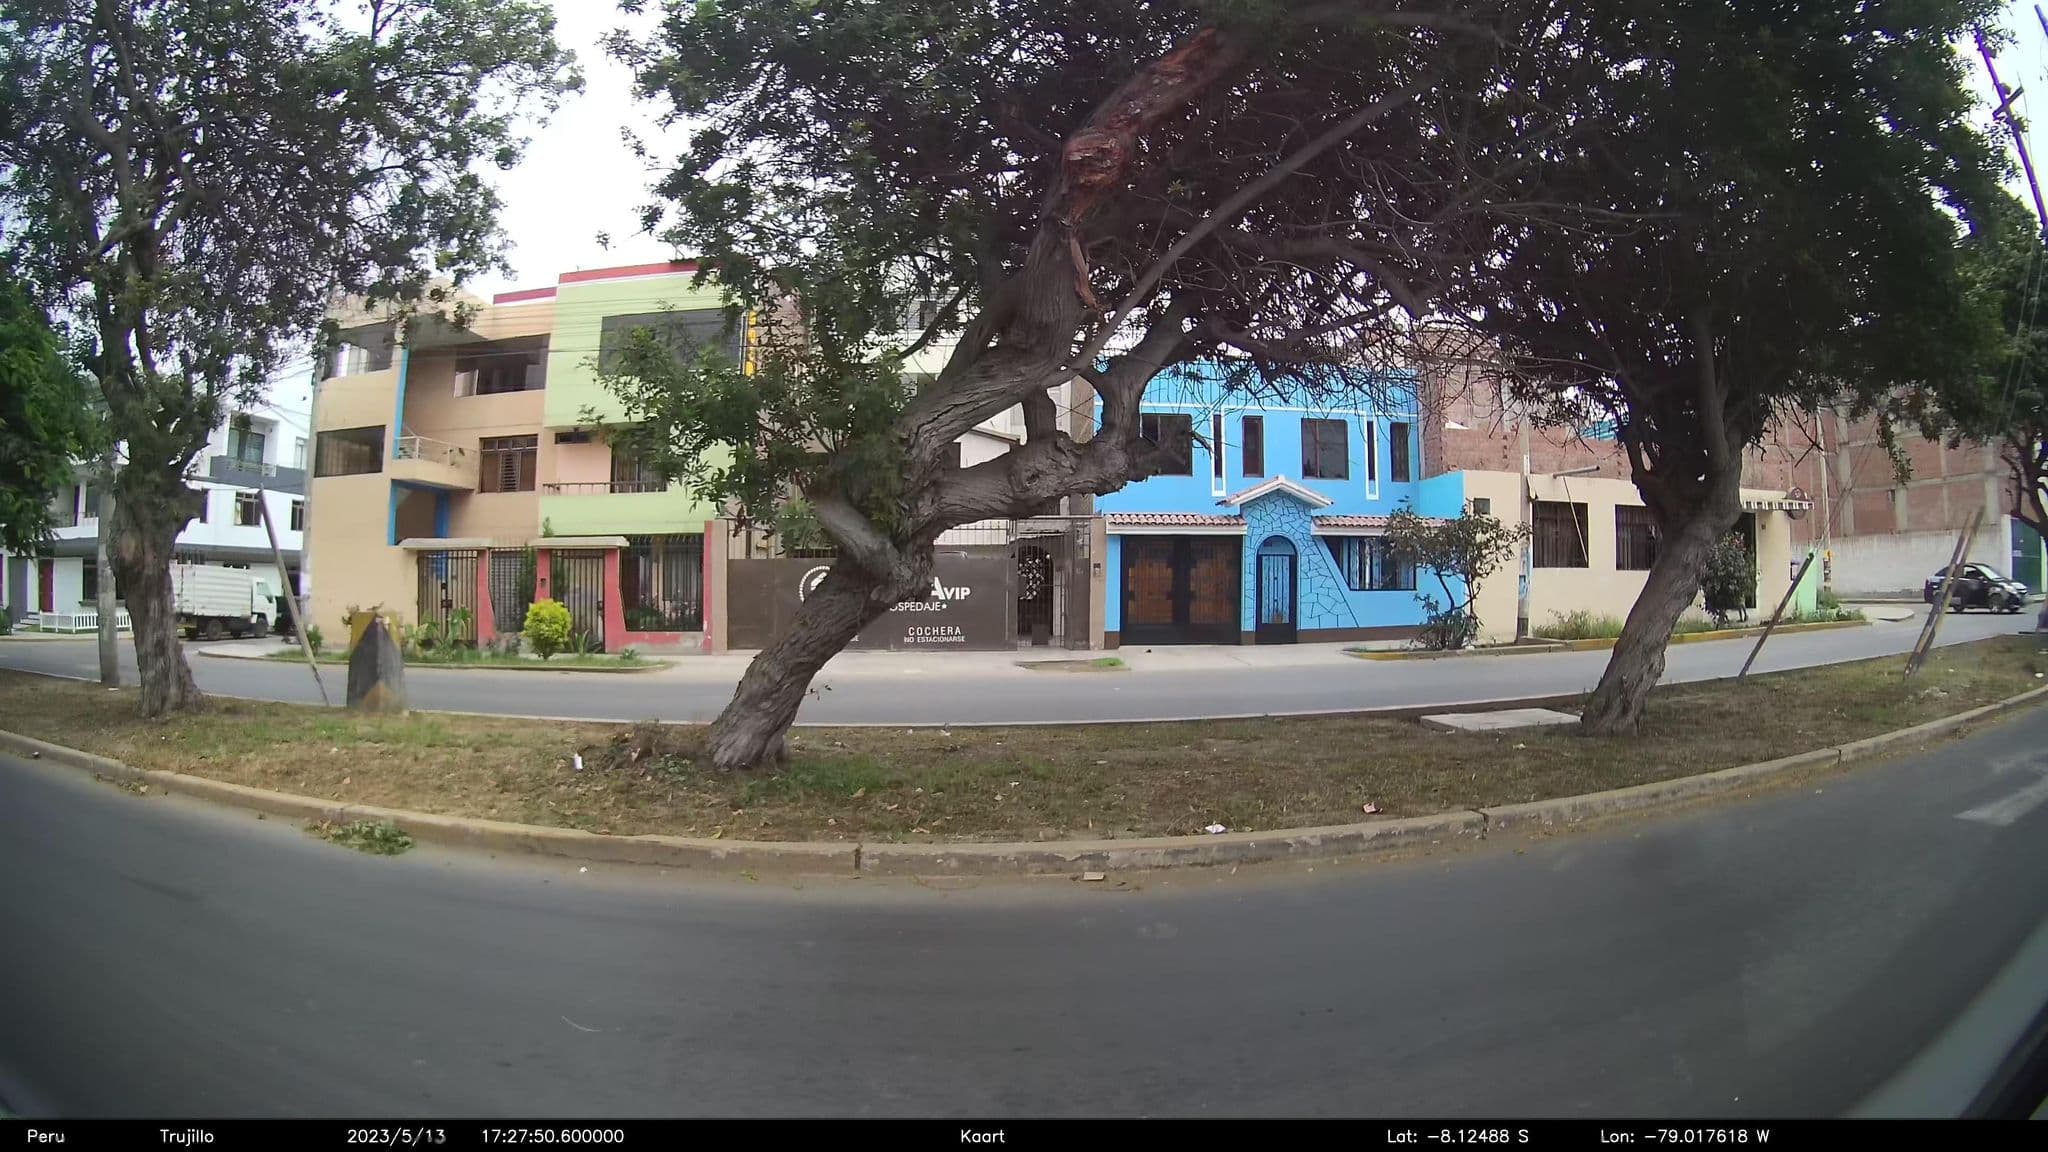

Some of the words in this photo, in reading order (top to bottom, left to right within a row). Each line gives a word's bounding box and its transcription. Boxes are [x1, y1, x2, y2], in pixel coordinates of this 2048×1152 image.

[889, 601, 941, 612] SPEDAJE
[908, 626, 961, 636] COCHERA
[917, 635, 965, 643] ESTACIONARSE
